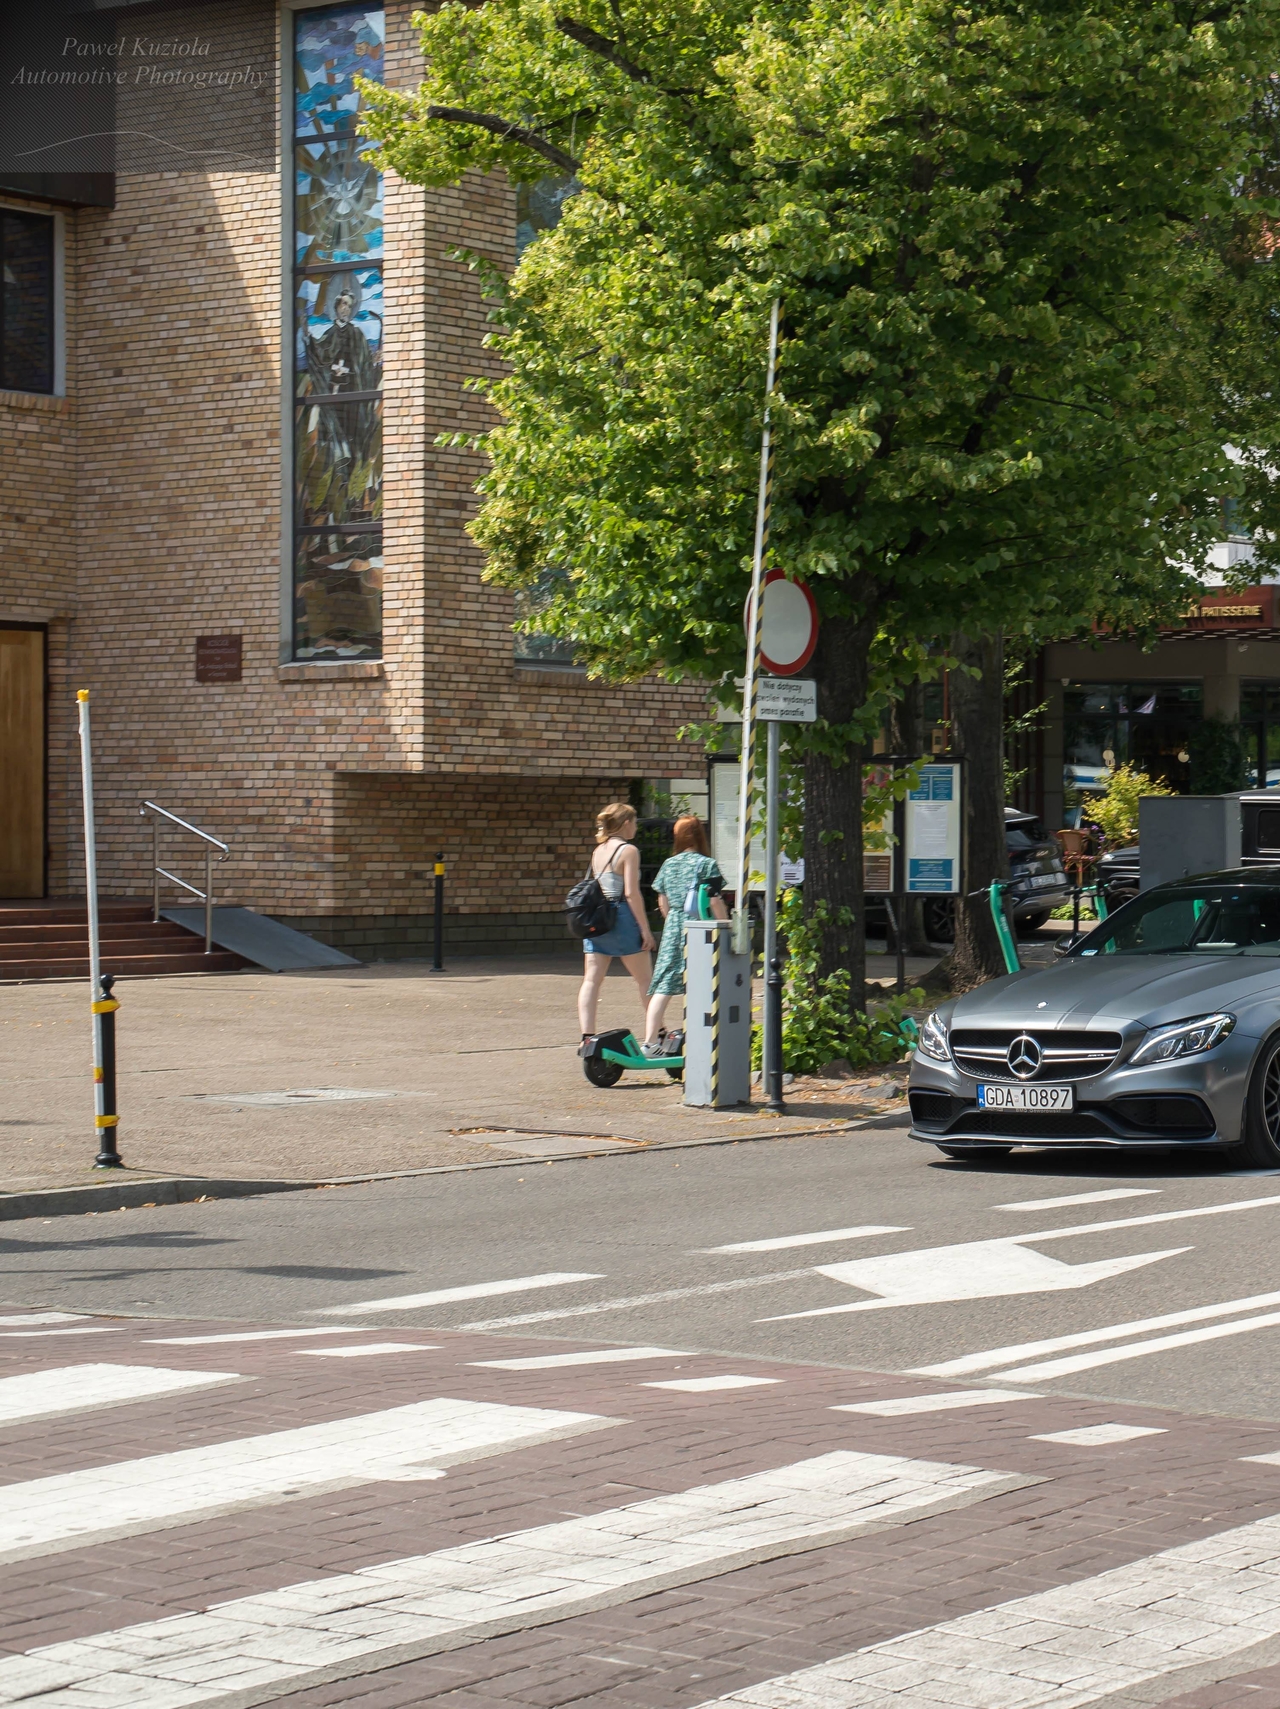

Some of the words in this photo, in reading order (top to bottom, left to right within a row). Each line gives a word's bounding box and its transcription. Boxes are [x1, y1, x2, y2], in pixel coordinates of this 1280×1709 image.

[777, 682, 803, 694] dotyczy
[986, 1087, 1014, 1106] GDA
[1021, 1088, 1070, 1107] 10897
